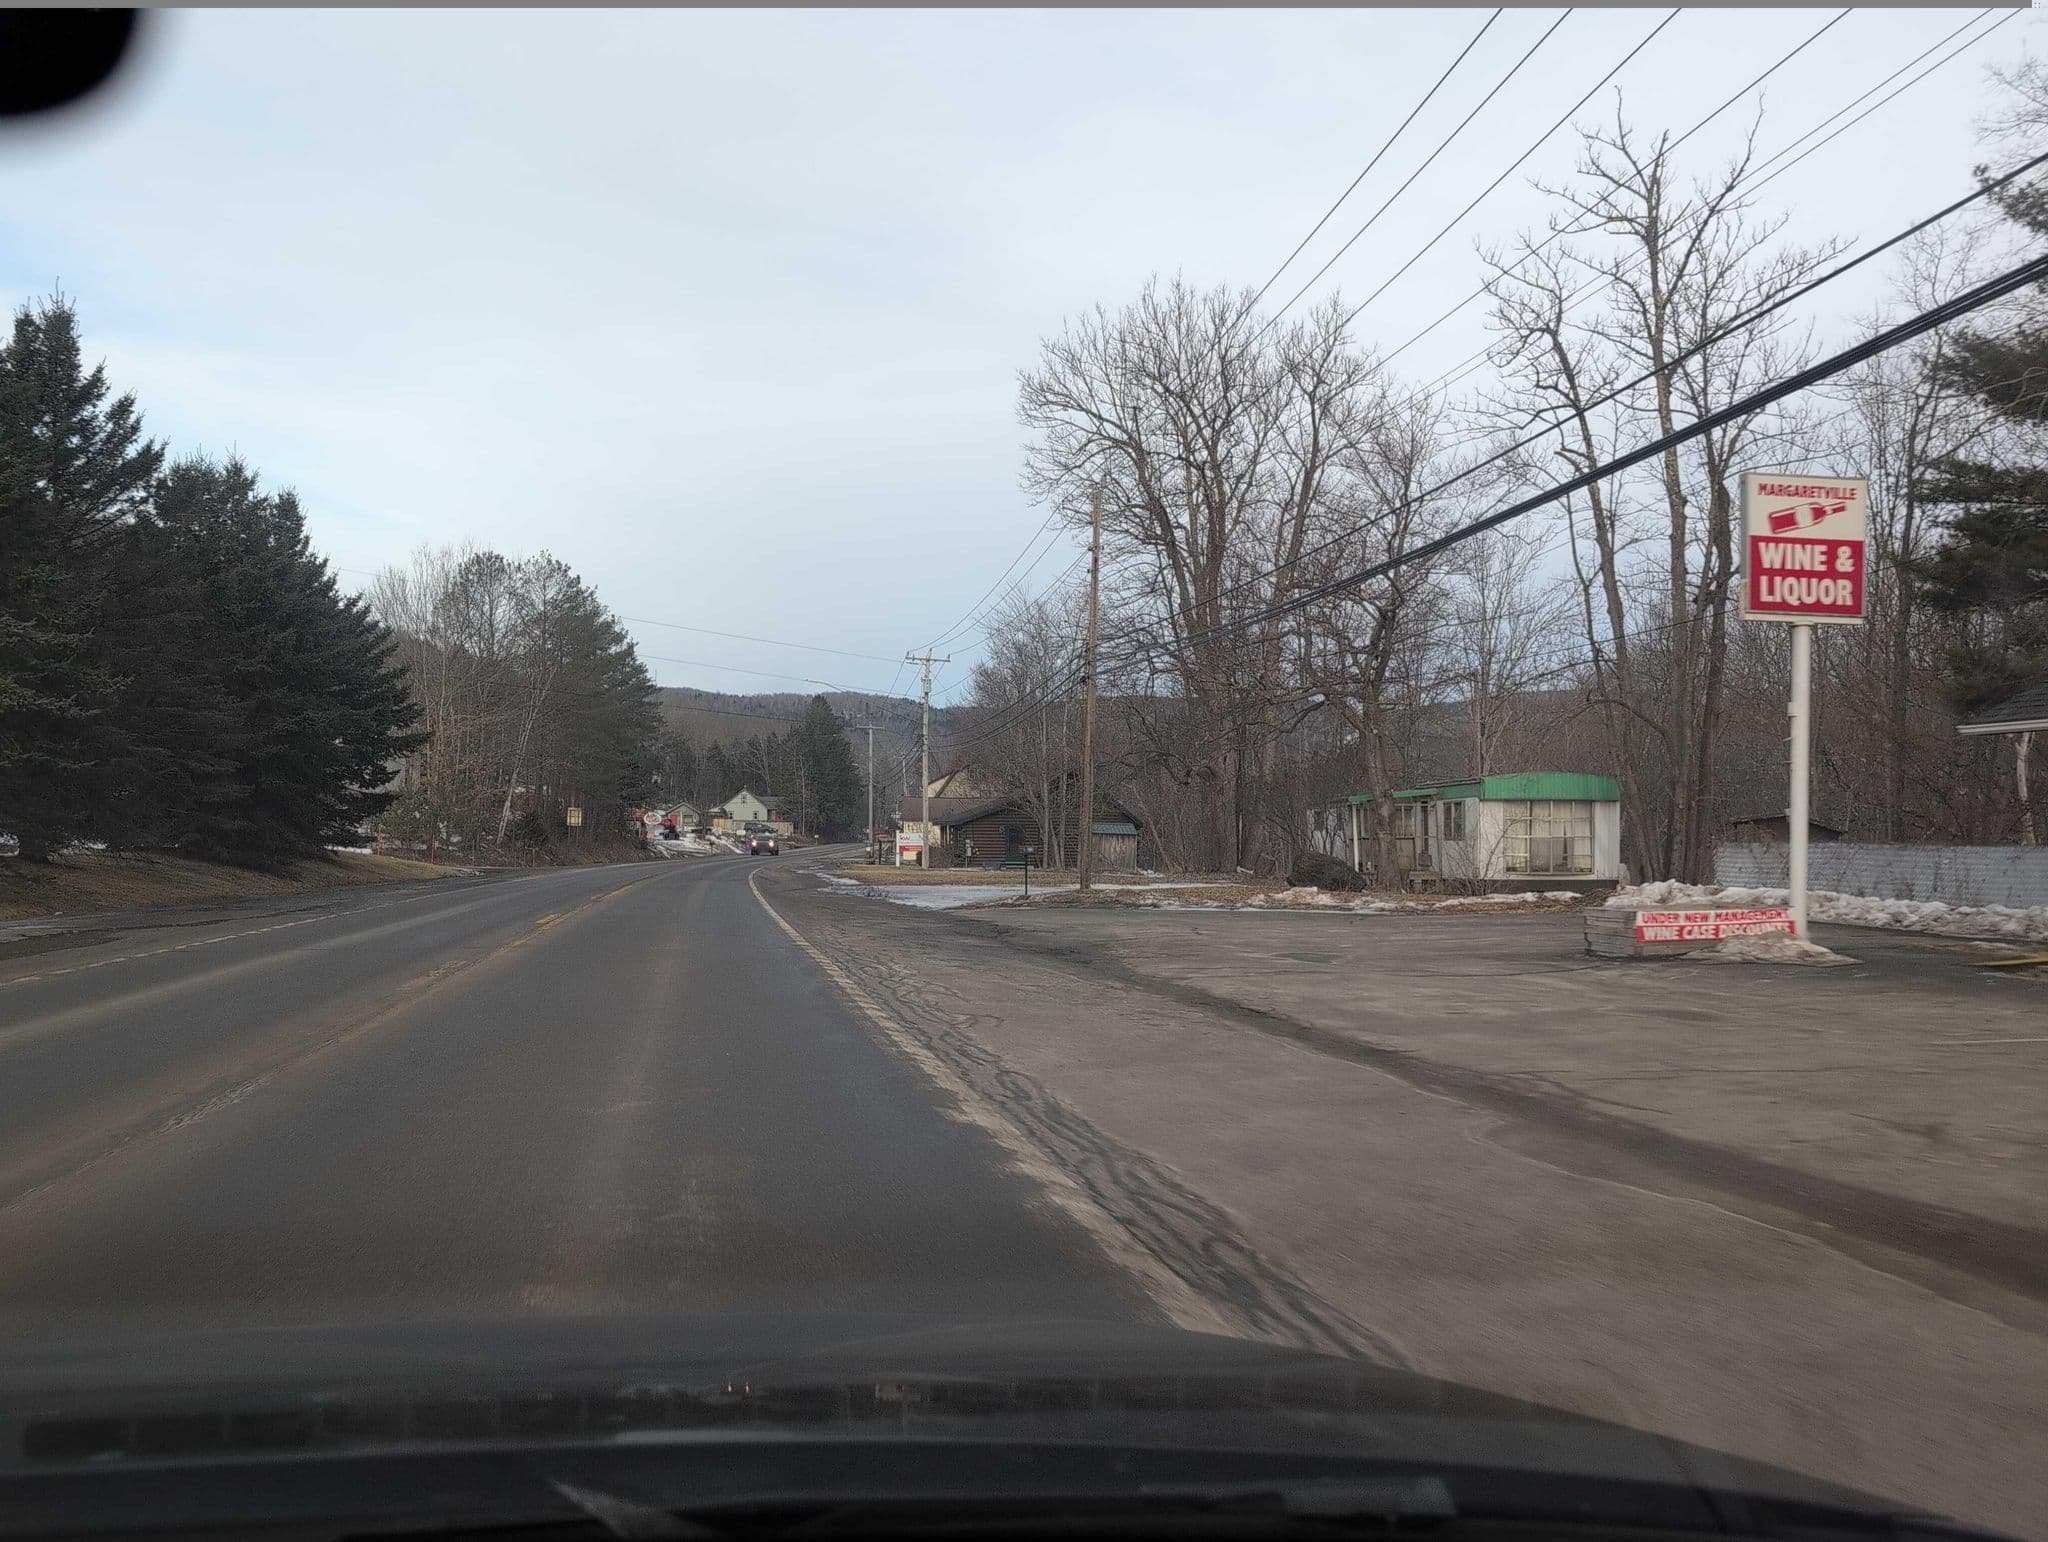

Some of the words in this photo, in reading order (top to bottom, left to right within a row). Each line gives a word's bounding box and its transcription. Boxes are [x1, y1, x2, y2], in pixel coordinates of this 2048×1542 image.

[1757, 483, 1857, 500] MARGARETVILLE
[1758, 542, 1828, 571] WINE
[1835, 546, 1855, 573] &
[1759, 575, 1853, 606] LIQUOR
[1642, 912, 1679, 924] UNDER
[1684, 911, 1709, 922] NEW
[1715, 908, 1788, 922] MANAGEMENT
[1643, 926, 1680, 940] WINE
[1682, 925, 1717, 939] CASE
